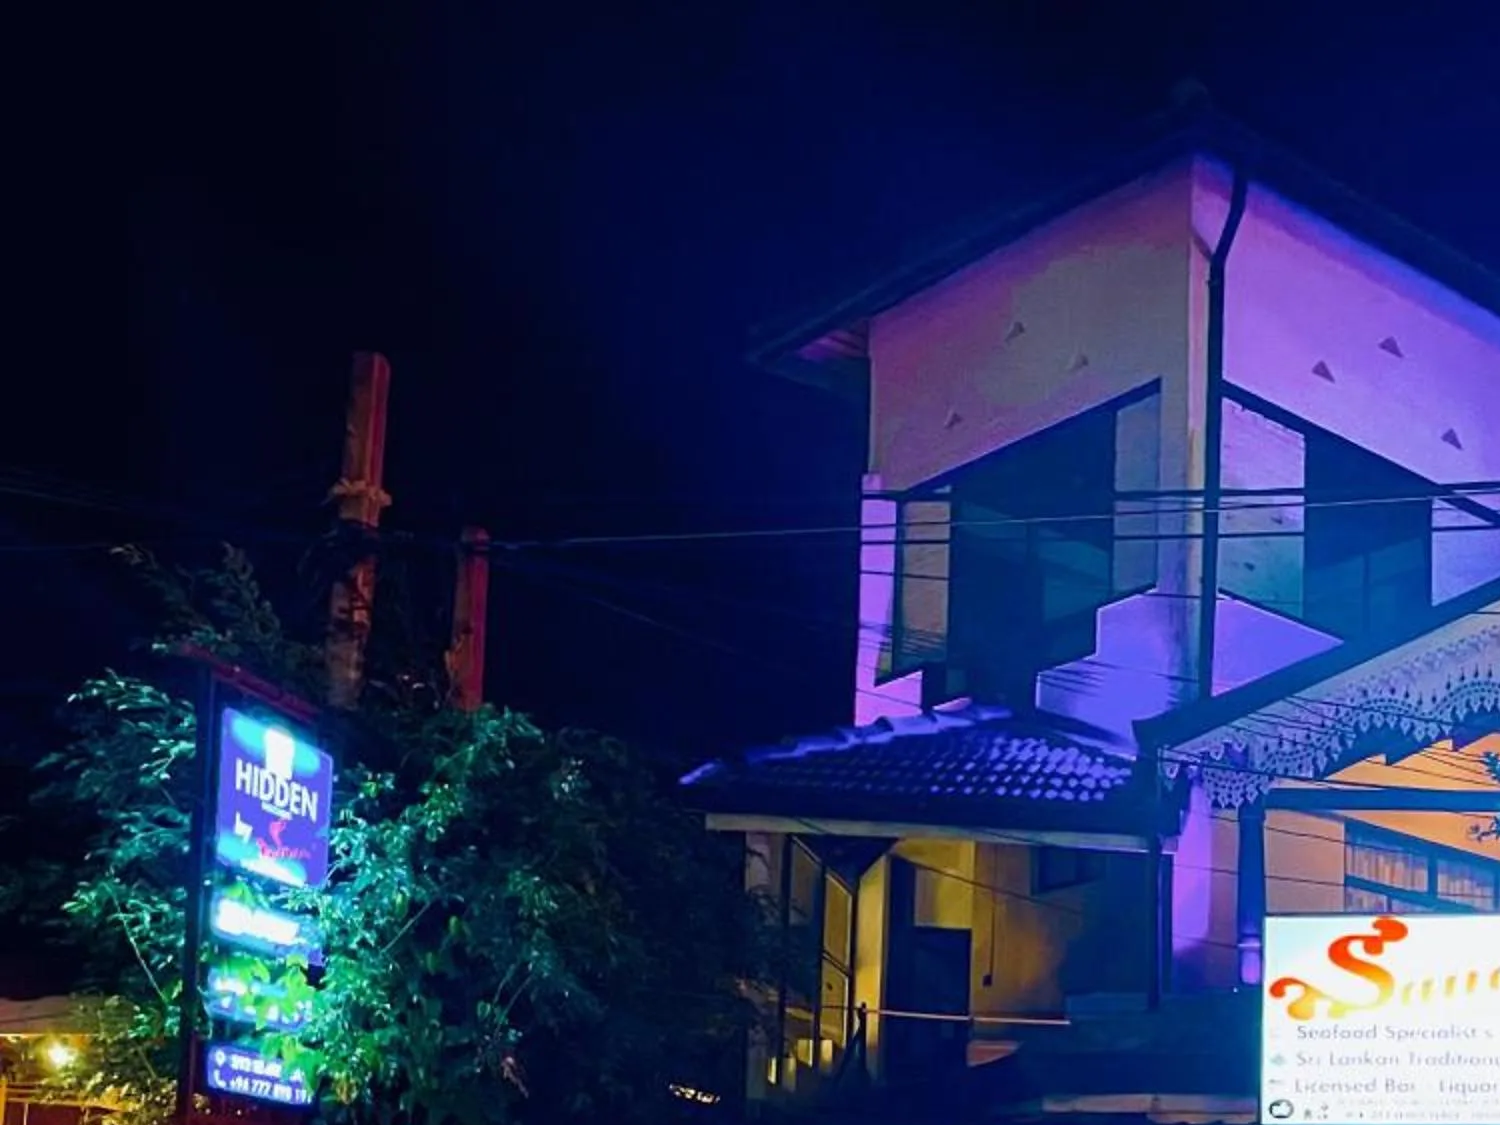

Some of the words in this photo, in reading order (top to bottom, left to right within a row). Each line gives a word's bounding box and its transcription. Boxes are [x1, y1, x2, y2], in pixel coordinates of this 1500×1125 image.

[235, 757, 318, 823] HIDDEN
[1296, 1025, 1378, 1041] Seafood
[1329, 1051, 1399, 1067] Lankan
